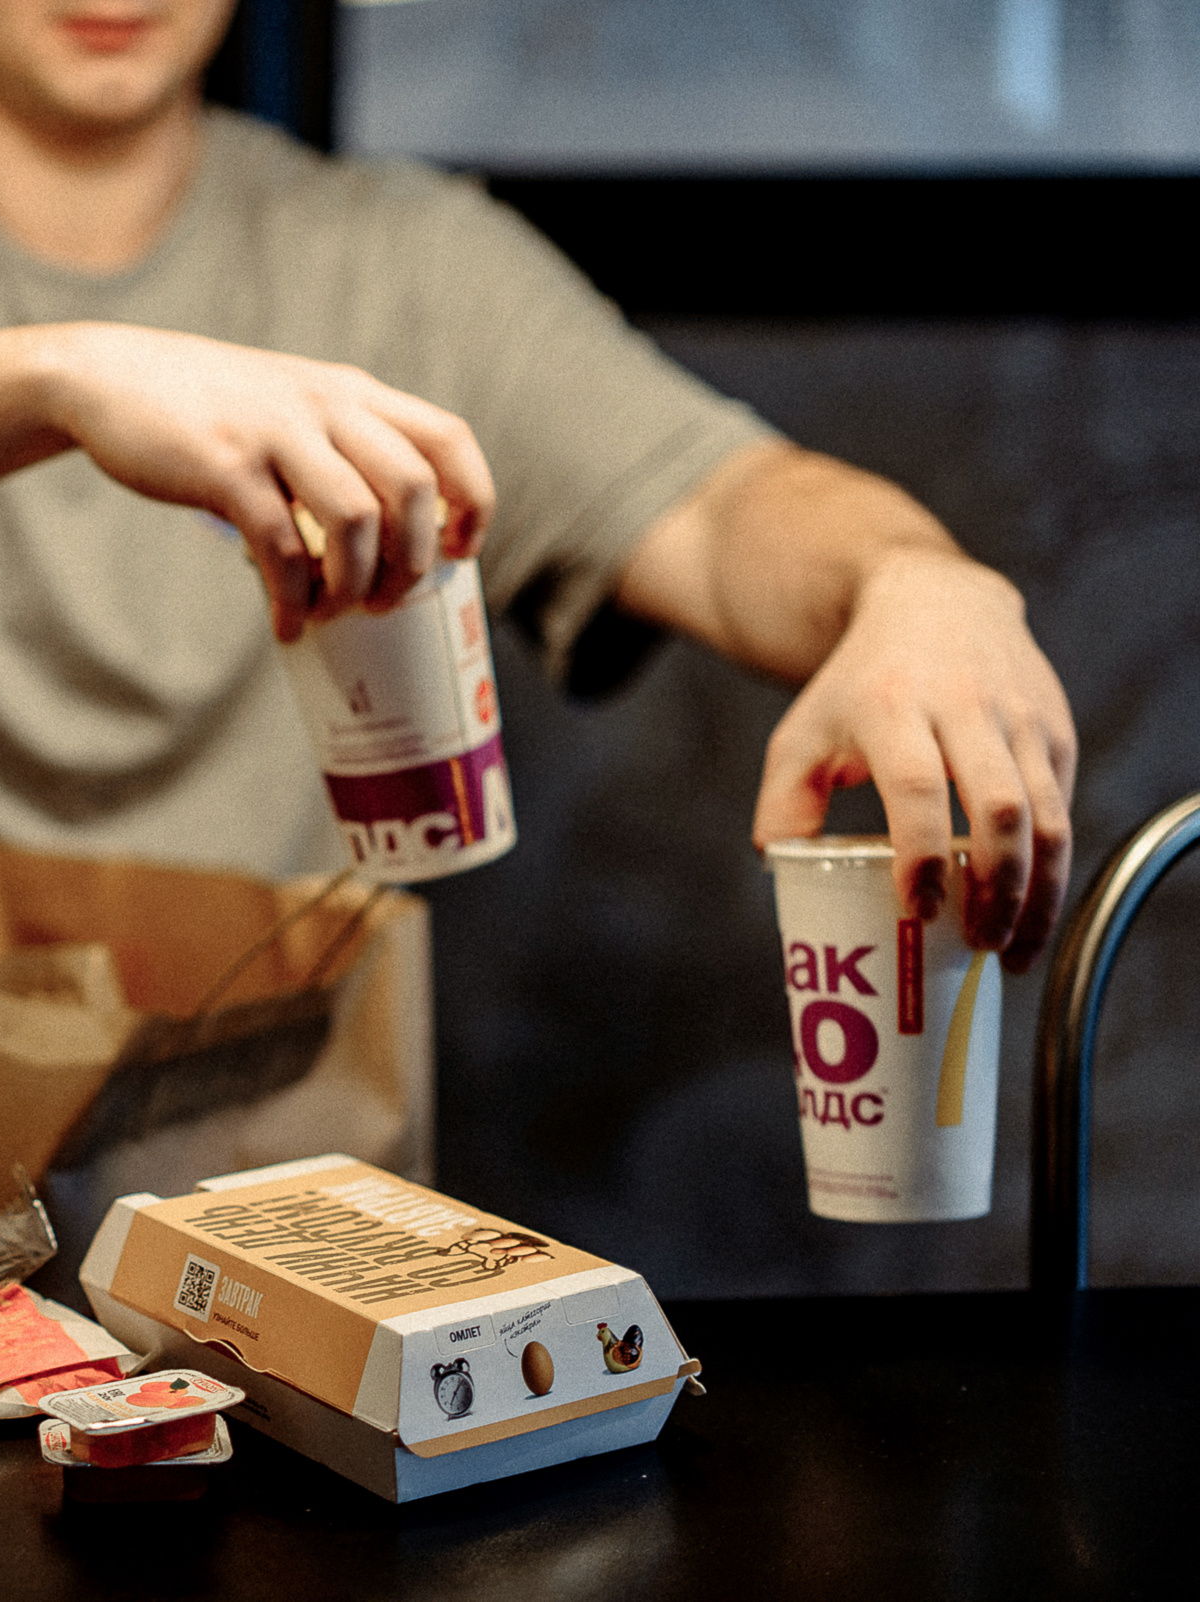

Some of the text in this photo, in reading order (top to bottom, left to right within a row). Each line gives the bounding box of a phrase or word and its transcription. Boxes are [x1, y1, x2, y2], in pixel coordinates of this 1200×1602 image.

[343, 812, 458, 868] лдс
[789, 940, 878, 996] ак
[801, 1000, 879, 1084] о
[800, 1088, 884, 1131] лдс
[319, 1177, 479, 1237] ЗАВТРАК
[184, 1204, 436, 1305] НАЧНИ ДЕНЬ
[249, 1190, 506, 1288] СО ВКУСОМ!
[218, 1275, 264, 1319] ЗАВТРАК
[212, 1311, 260, 1341] УЗНАЙТЕ БОЛЬШЕ
[449, 1325, 482, 1343] ОМЛЕТ
